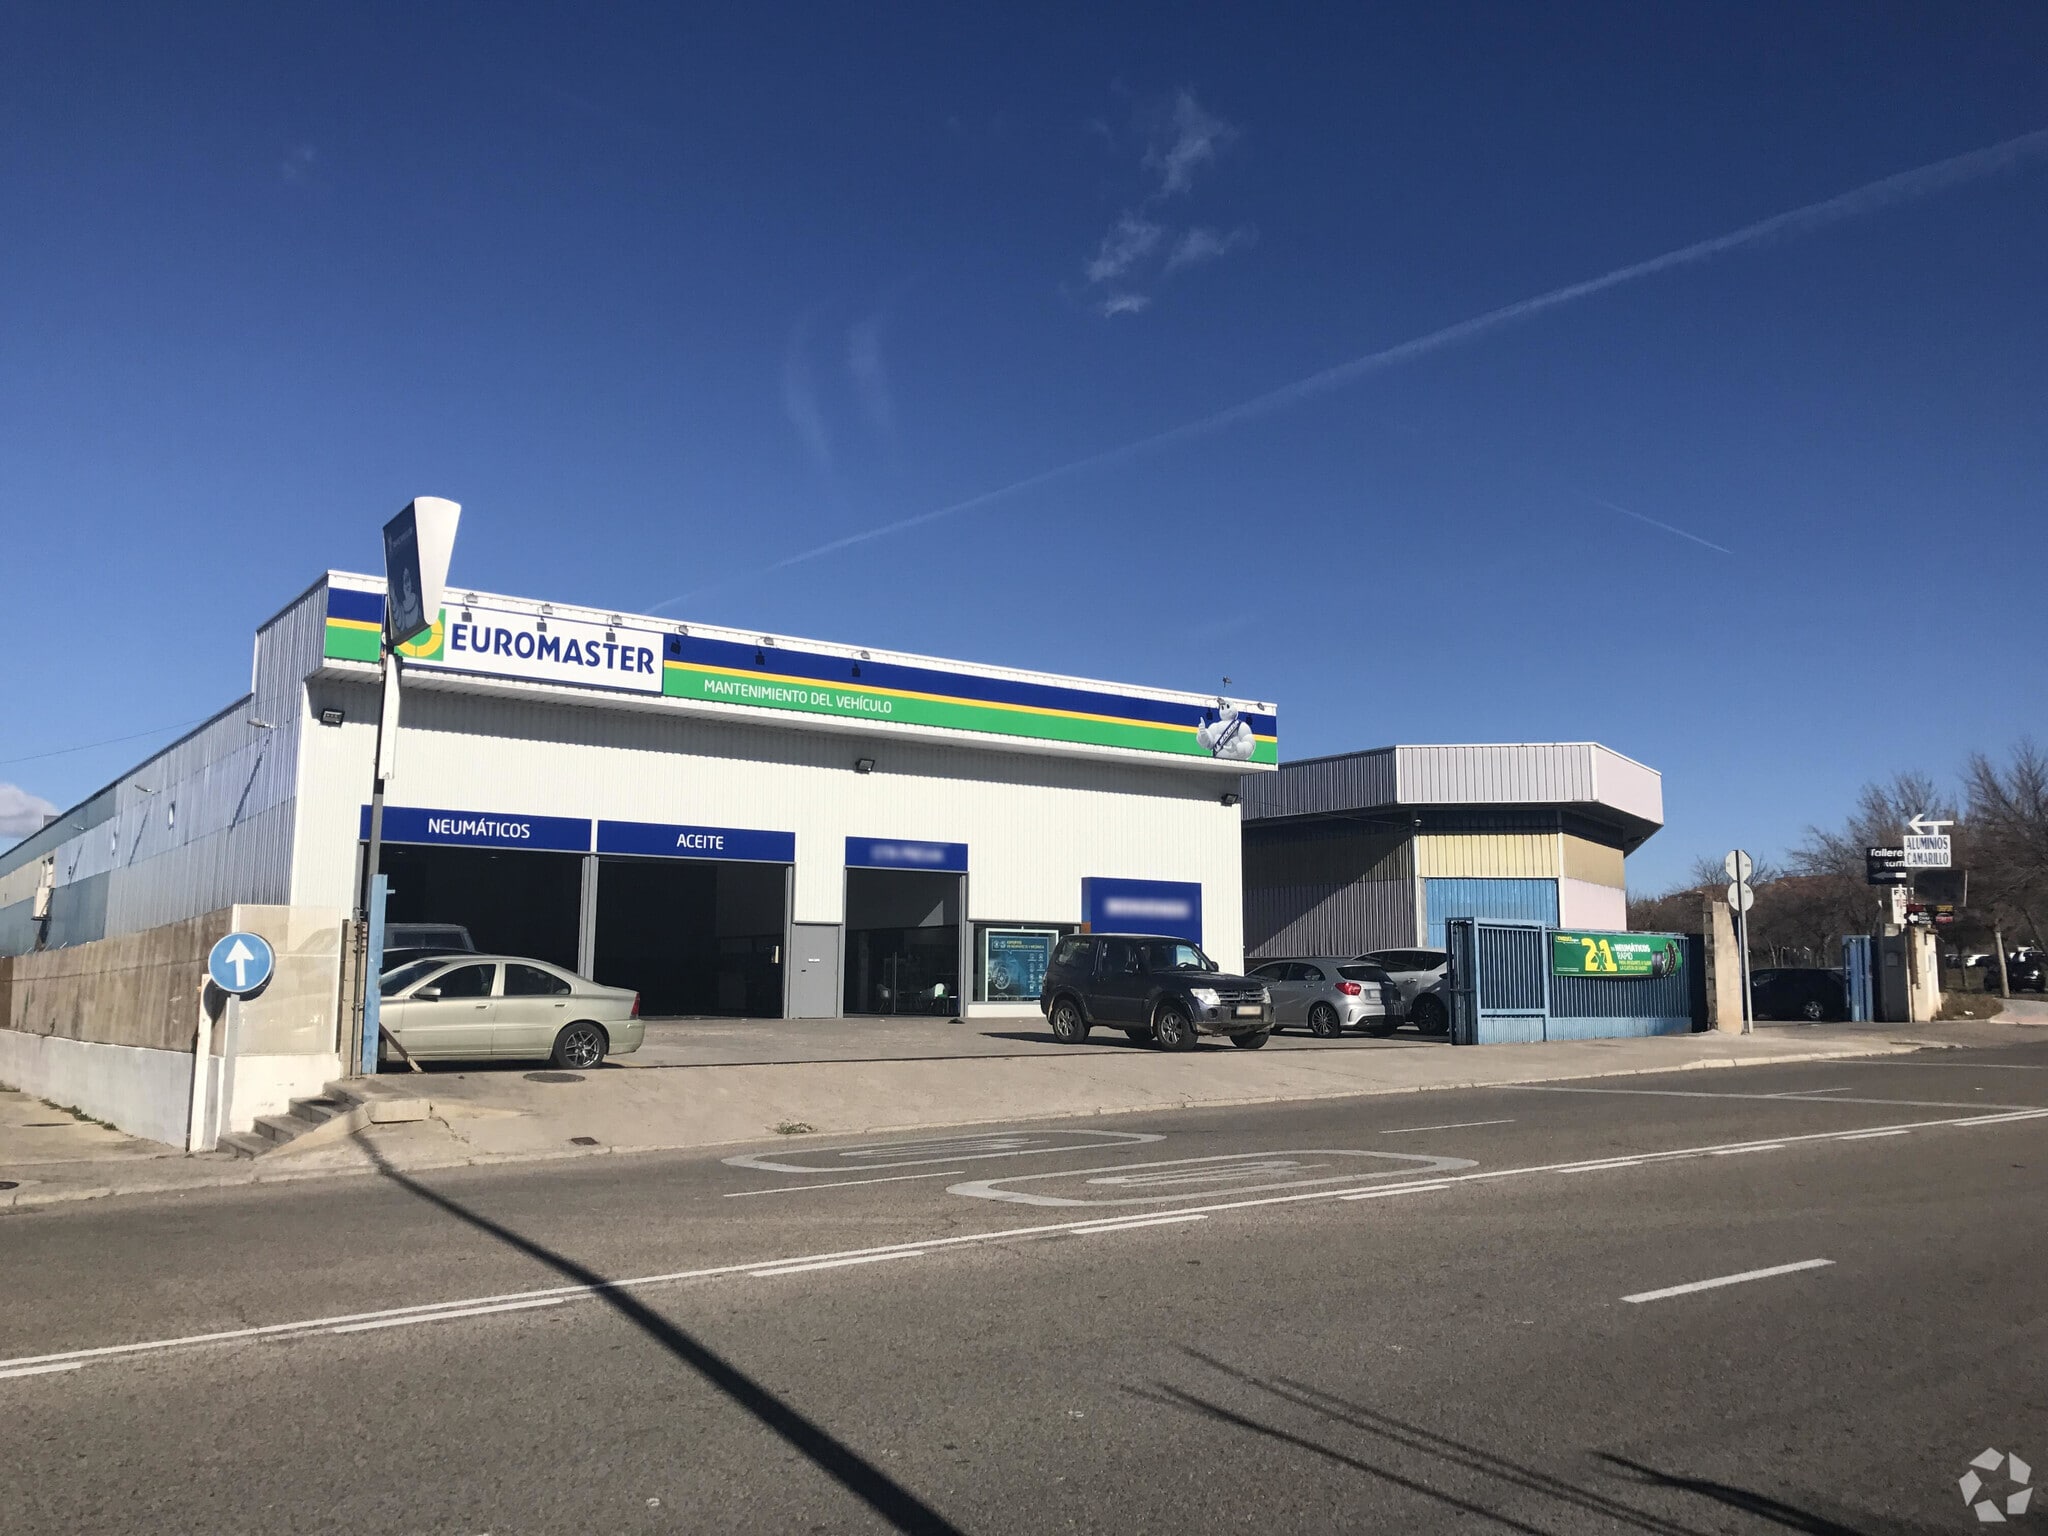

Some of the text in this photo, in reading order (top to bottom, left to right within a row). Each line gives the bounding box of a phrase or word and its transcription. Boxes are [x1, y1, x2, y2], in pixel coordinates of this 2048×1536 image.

[451, 623, 655, 675] EUROMASTER
[704, 680, 892, 713] MANTENIMIENTO DEL VEHÍCULO
[428, 818, 531, 838] NEUMÁTICOS
[676, 833, 724, 850] ACEITE
[1906, 837, 1948, 850] ALUMINIOS
[1870, 848, 1904, 857] Tallere
[1906, 852, 1949, 865] CAMARILLO
